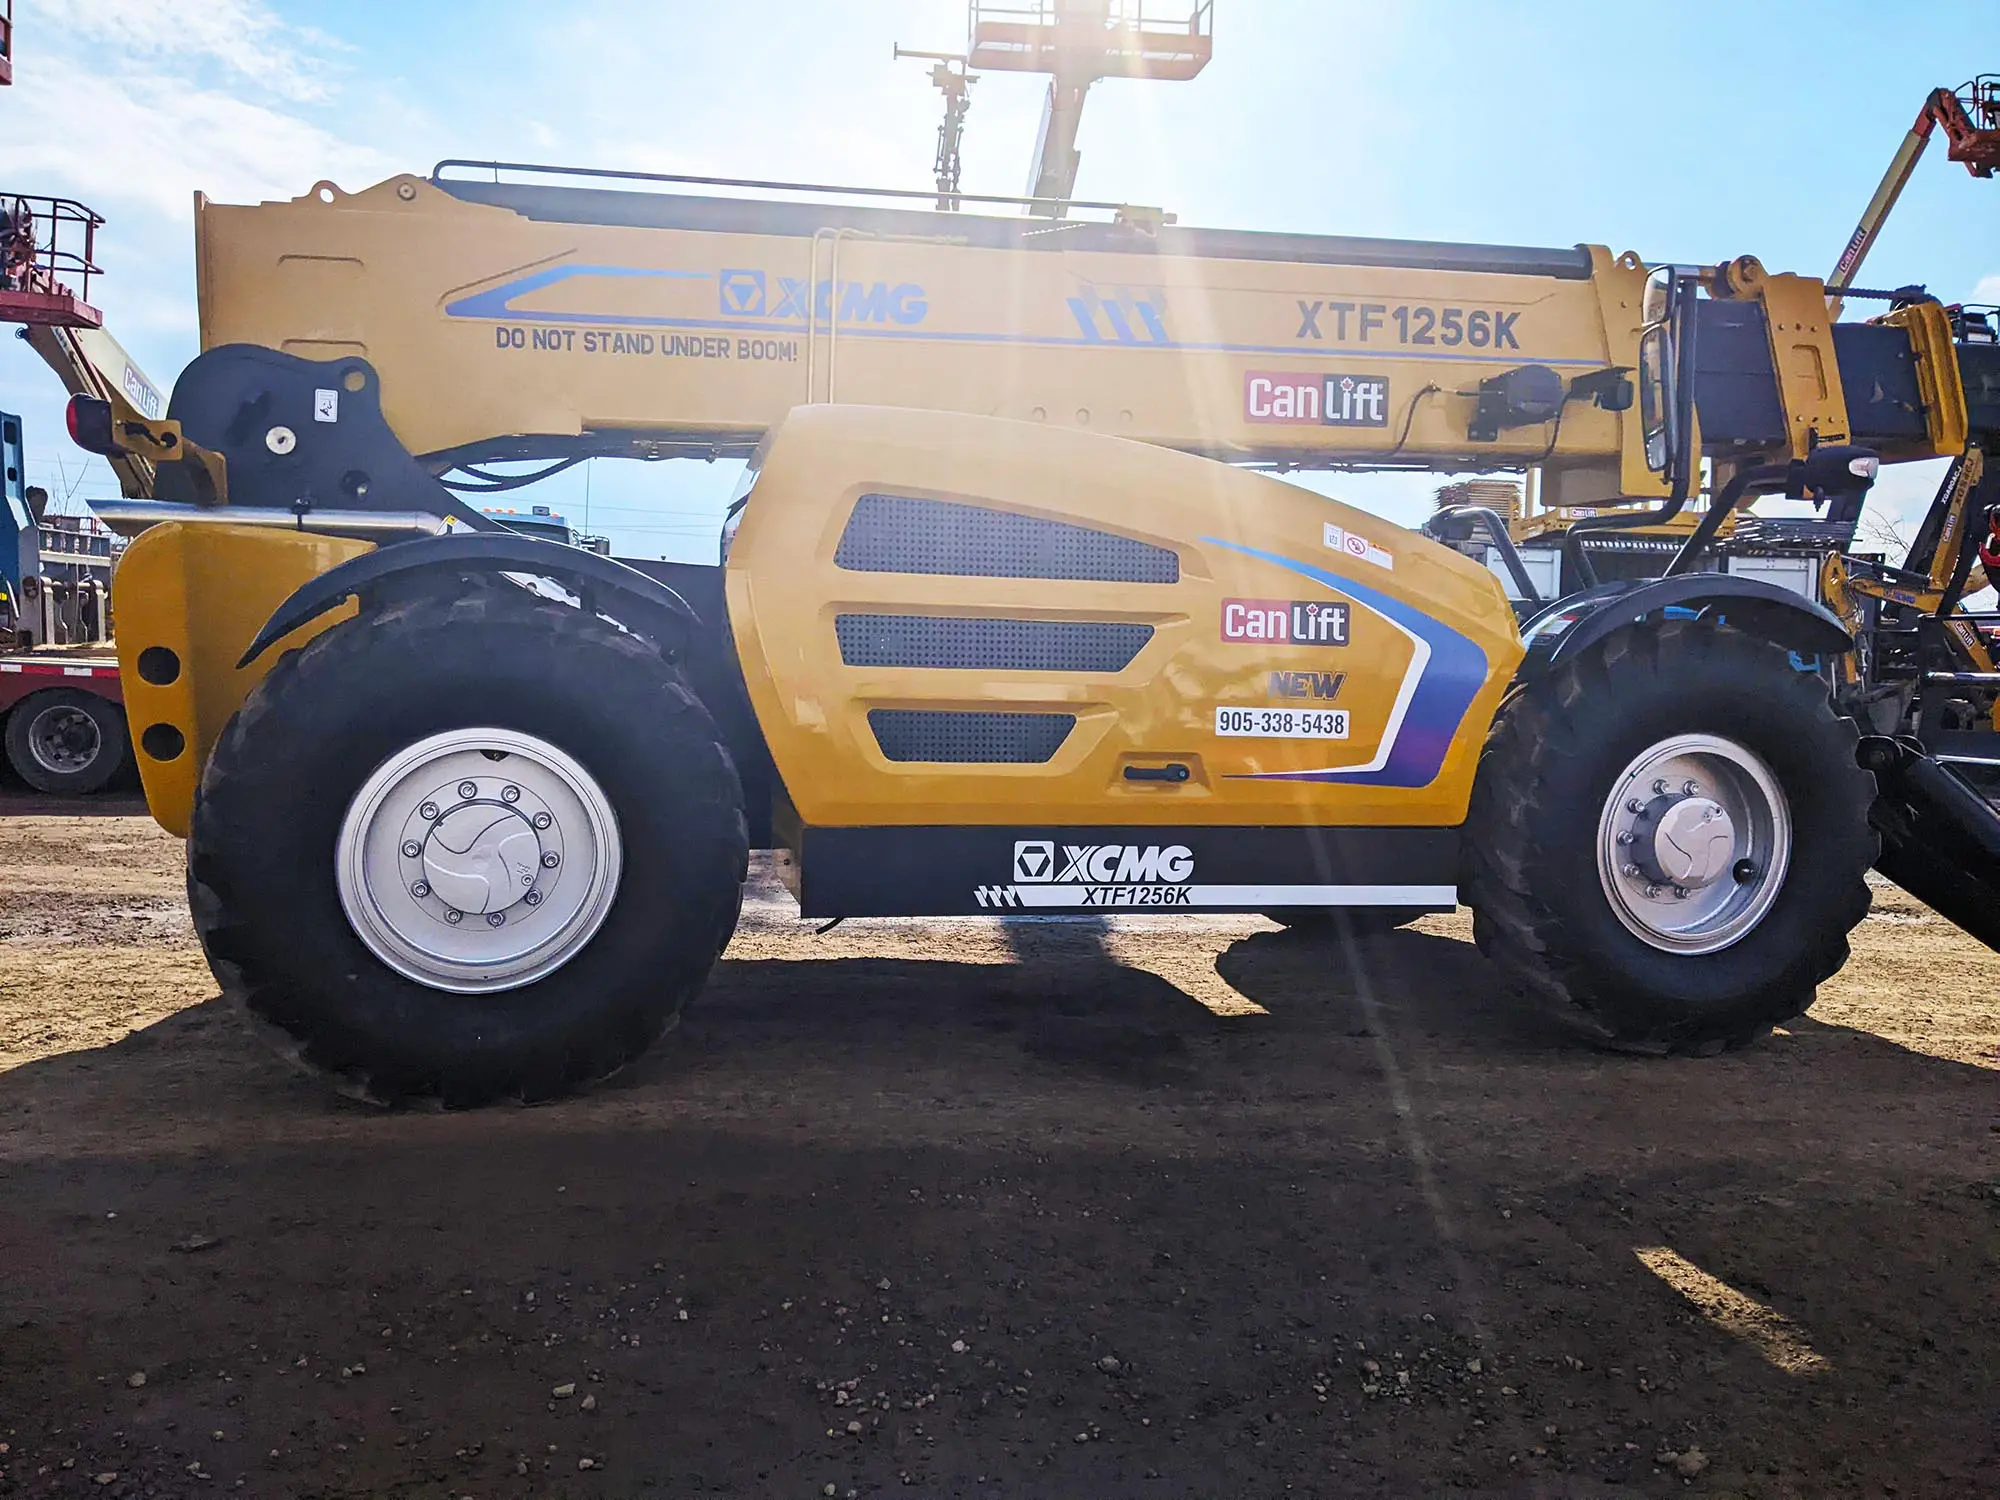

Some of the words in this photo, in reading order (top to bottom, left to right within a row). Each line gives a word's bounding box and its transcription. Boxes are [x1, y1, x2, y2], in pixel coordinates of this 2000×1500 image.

[768, 277, 928, 325] XCMG
[1296, 300, 1521, 350] XTF1256K
[496, 326, 525, 349] DO
[533, 328, 576, 352] NOT
[583, 331, 655, 355] STAND
[661, 334, 731, 359] UNDER
[736, 338, 799, 362] BOOM!
[1267, 670, 1348, 701] NEW
[1219, 711, 1345, 735] 905-338-5438
[1053, 845, 1195, 883] XCMG
[1081, 887, 1193, 905] XTF1256K
